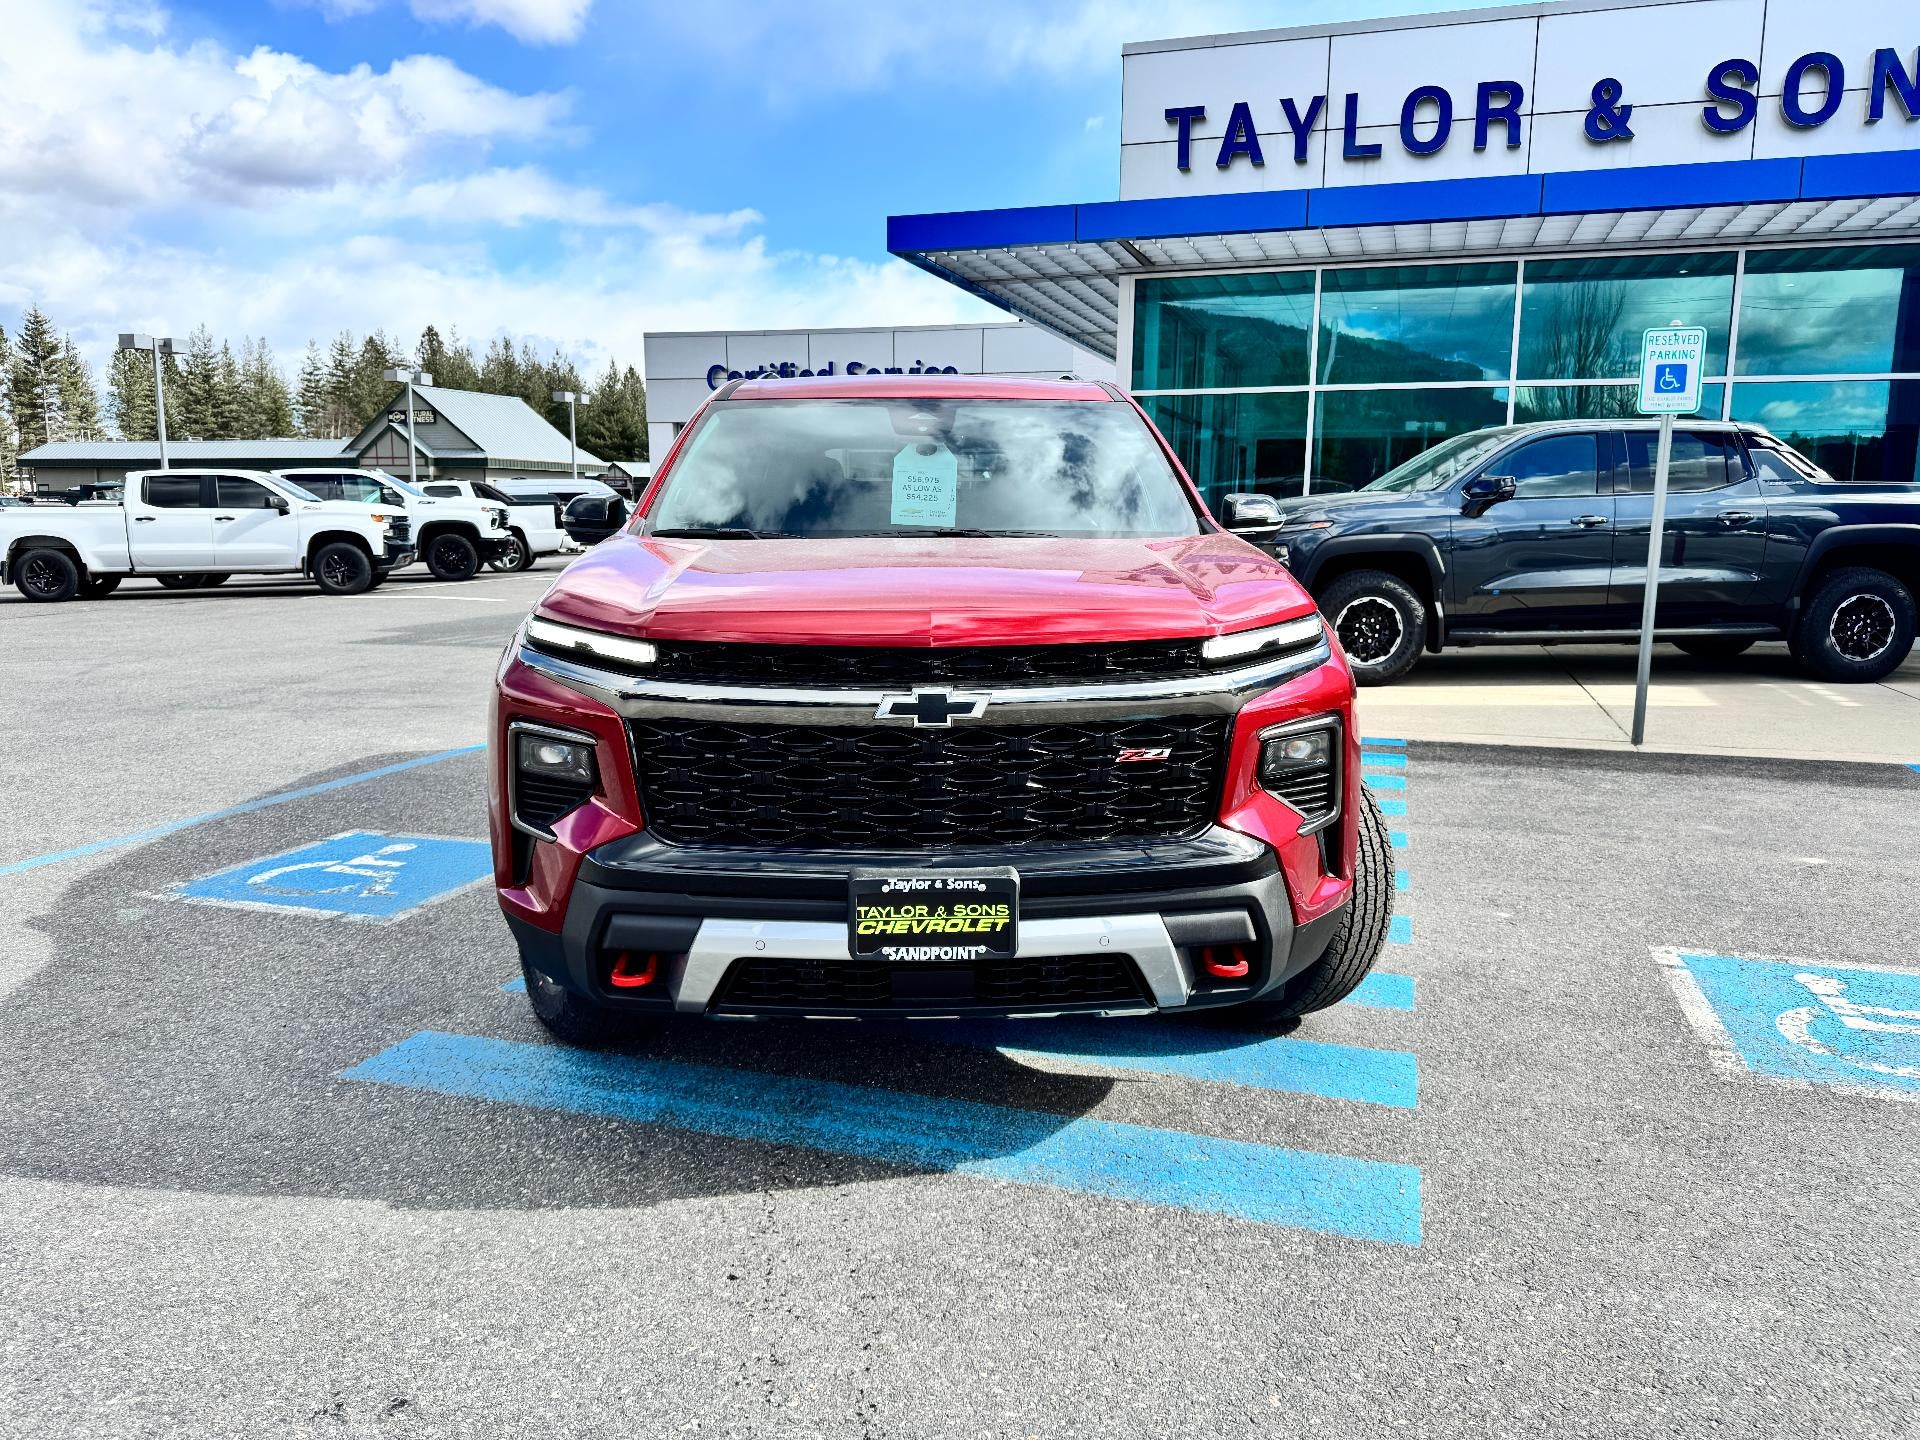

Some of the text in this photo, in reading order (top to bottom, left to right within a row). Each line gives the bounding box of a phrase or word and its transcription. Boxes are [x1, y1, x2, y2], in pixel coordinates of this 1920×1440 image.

[1164, 80, 1525, 172] TAYLOR
[1583, 76, 1635, 142] &
[1648, 334, 1700, 346] RESERVED
[1649, 349, 1696, 360] PARKING
[887, 878, 980, 893] Taylor & Sons
[857, 904, 1010, 919] TAYLOR & SONS
[857, 918, 1010, 935] CHEVROLET
[888, 946, 979, 961] SANDPOINT
